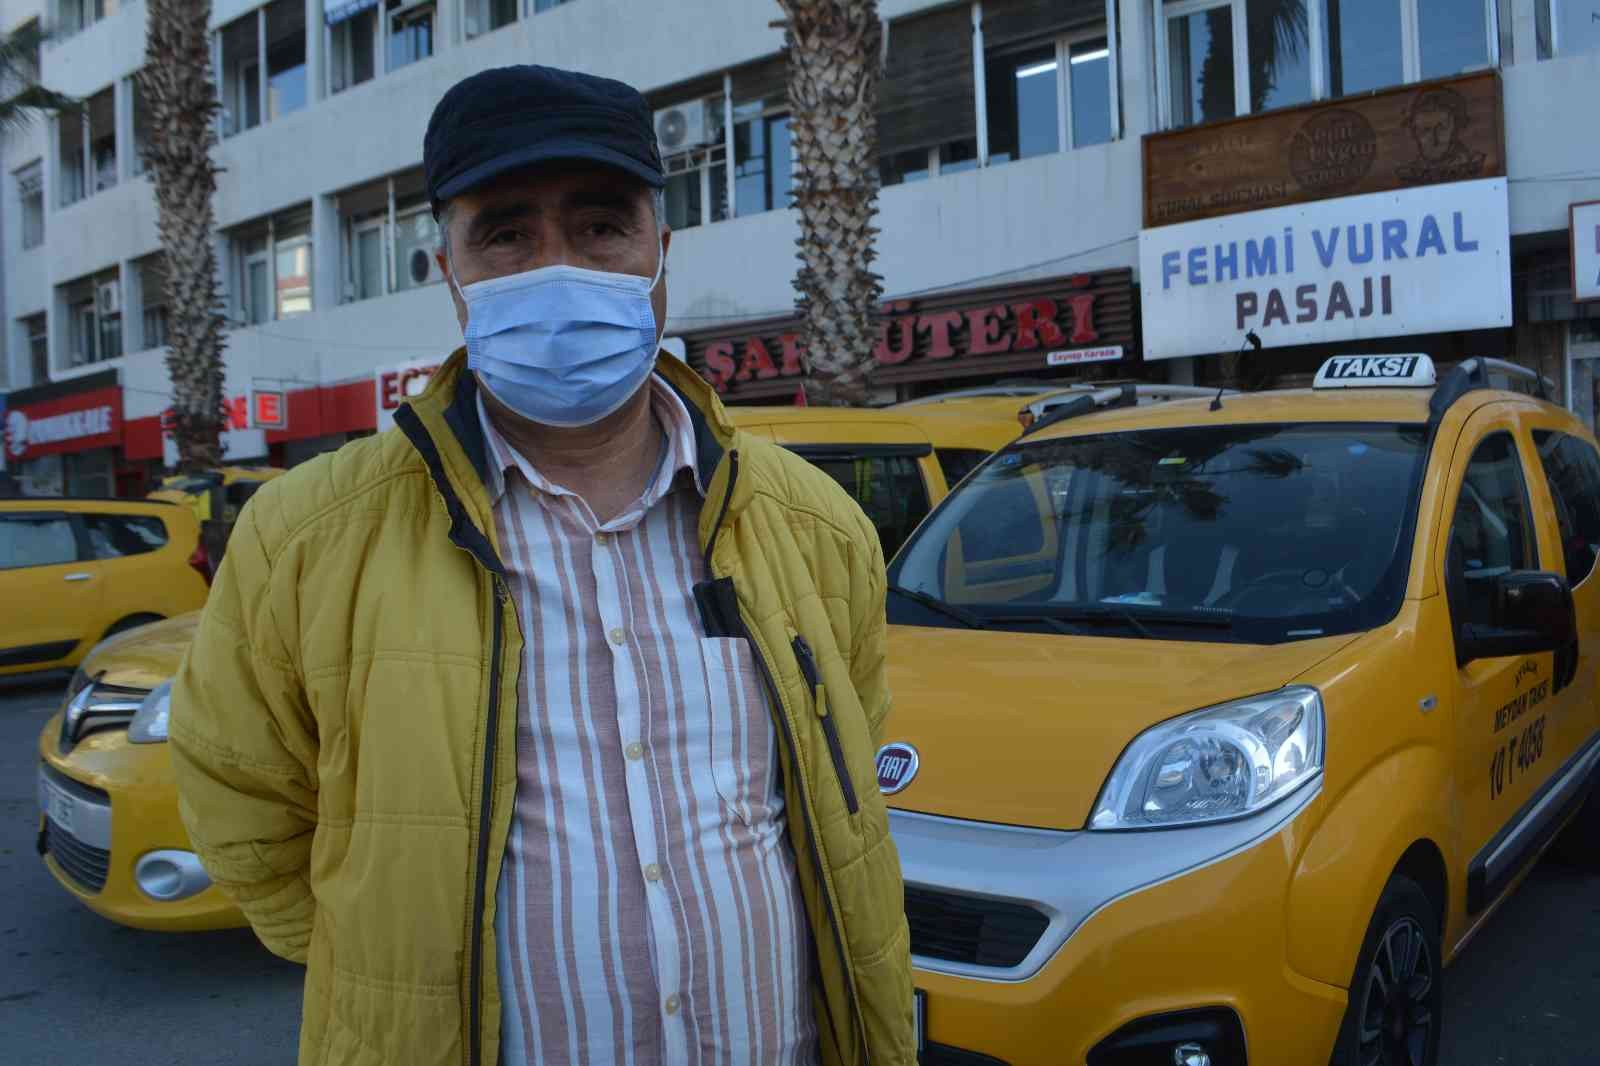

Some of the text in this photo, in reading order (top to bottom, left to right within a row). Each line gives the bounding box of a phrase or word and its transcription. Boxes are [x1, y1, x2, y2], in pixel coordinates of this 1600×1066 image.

[1161, 211, 1480, 290] FEHMİ VURAL
[1235, 275, 1393, 331] PASAJI
[1331, 356, 1413, 377] TAKSİ
[259, 394, 281, 423] E
[877, 755, 907, 780] FIAT
[1489, 746, 1505, 801] 10
[1508, 736, 1518, 785] T
